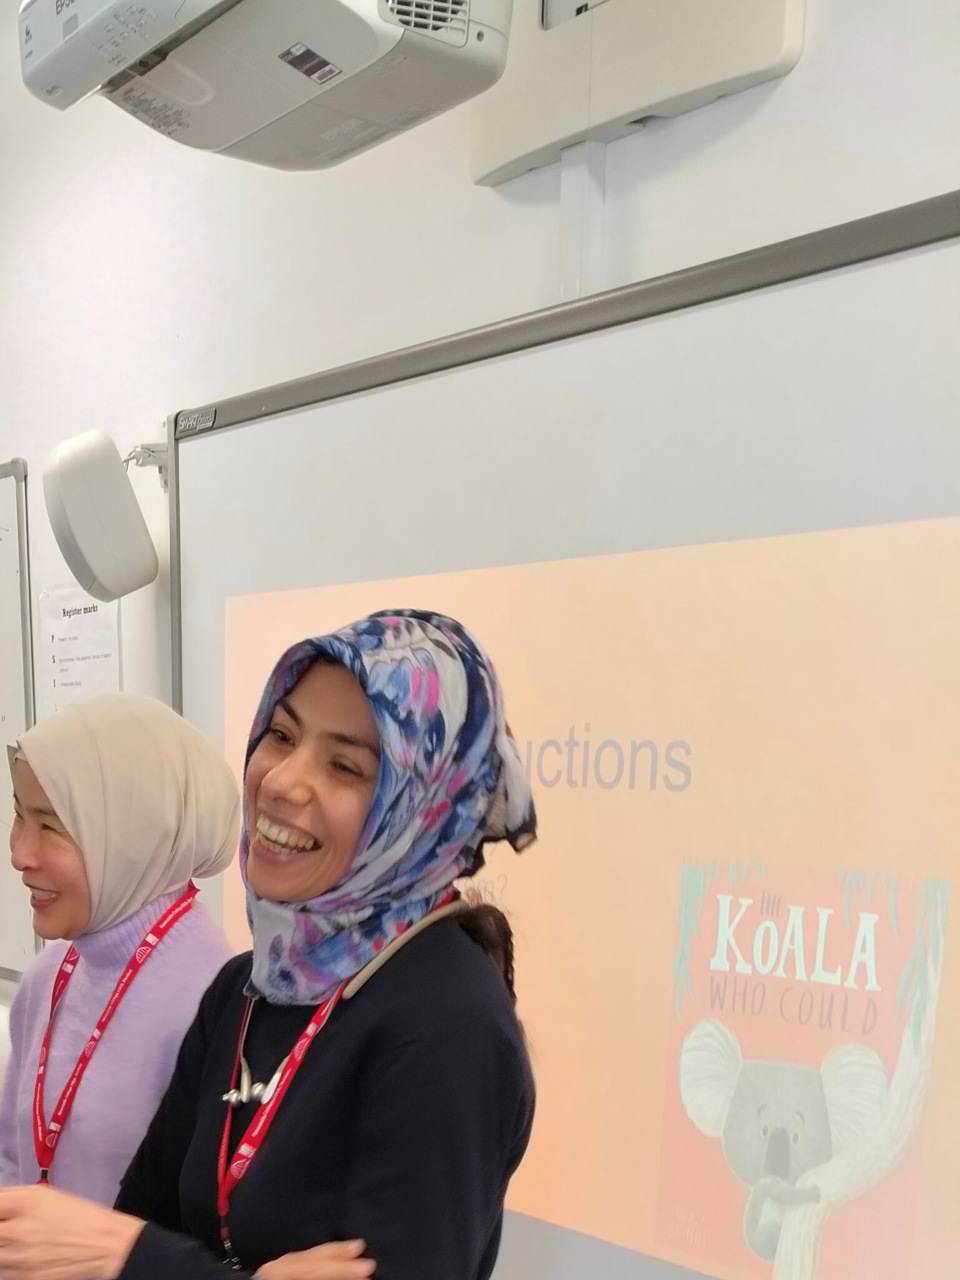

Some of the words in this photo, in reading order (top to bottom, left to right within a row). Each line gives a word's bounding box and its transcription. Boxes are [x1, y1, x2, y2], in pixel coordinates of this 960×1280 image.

[62, 607, 82, 619] Register
[83, 603, 98, 614] marks
[51, 634, 55, 643] P
[52, 655, 56, 664] S
[710, 976, 766, 1017] WHO
[780, 986, 878, 1036] COULD
